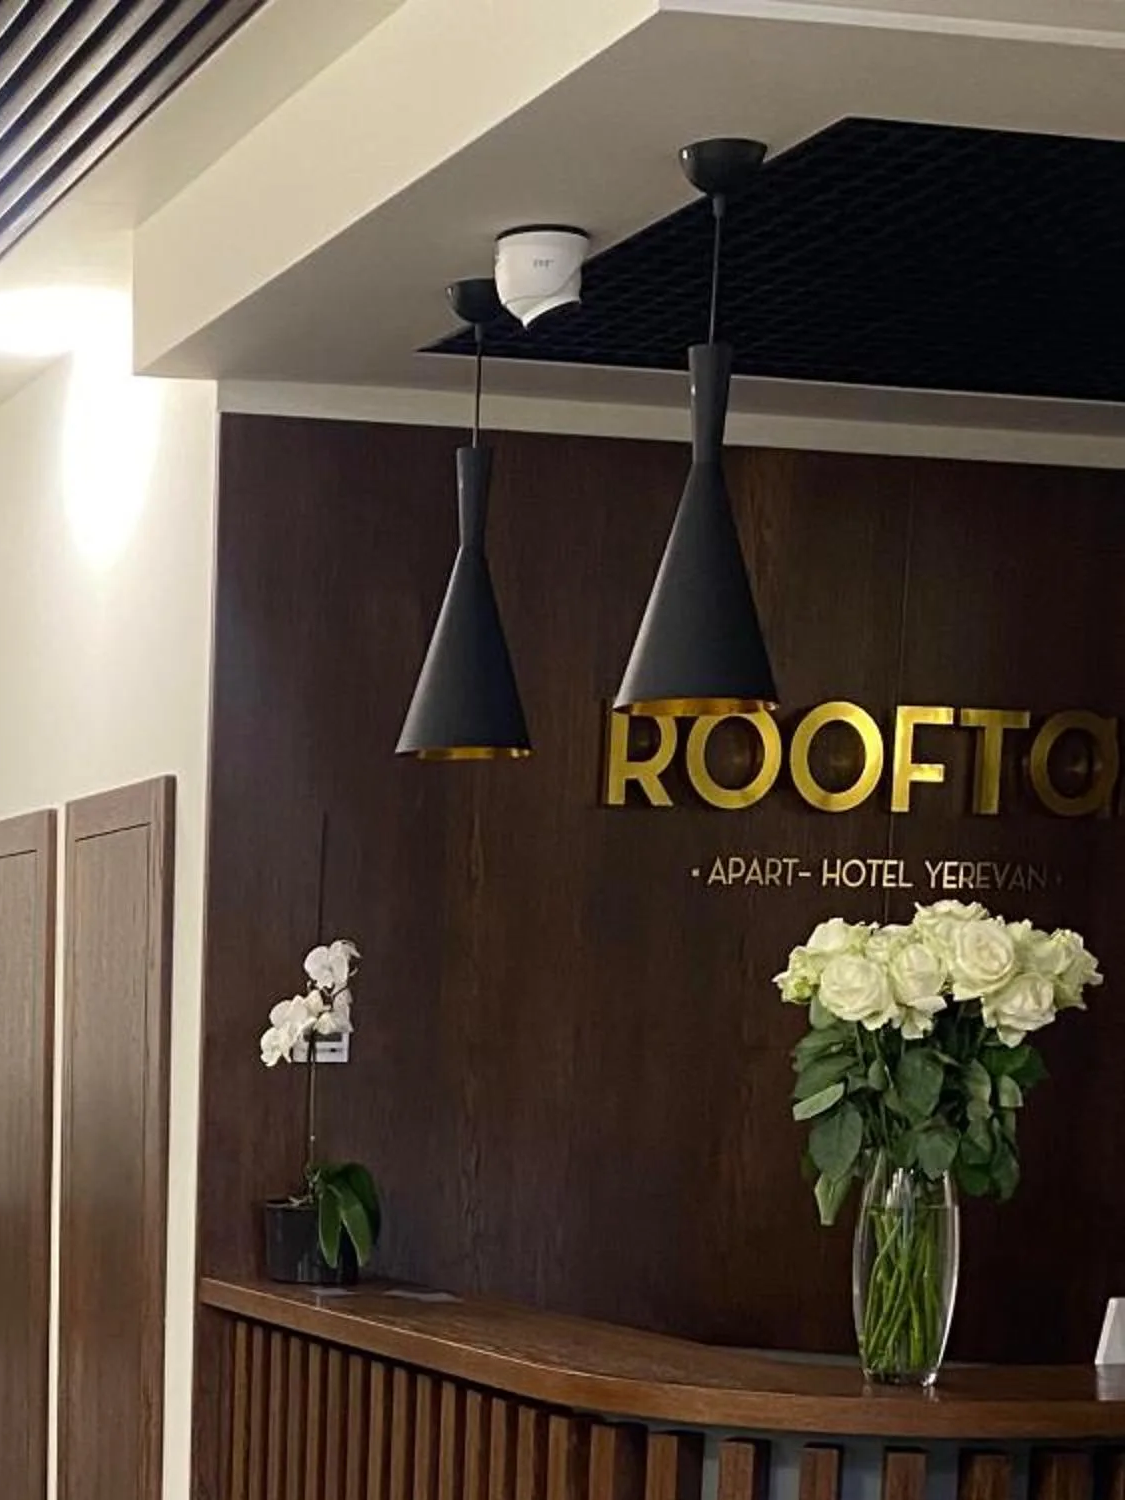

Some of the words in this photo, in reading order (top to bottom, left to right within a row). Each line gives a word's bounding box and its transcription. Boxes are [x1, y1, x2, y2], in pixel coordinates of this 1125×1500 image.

[608, 701, 1125, 816] ROOFTO
[822, 858, 914, 888] HOTEL
[925, 860, 1047, 891] YEREVAN
